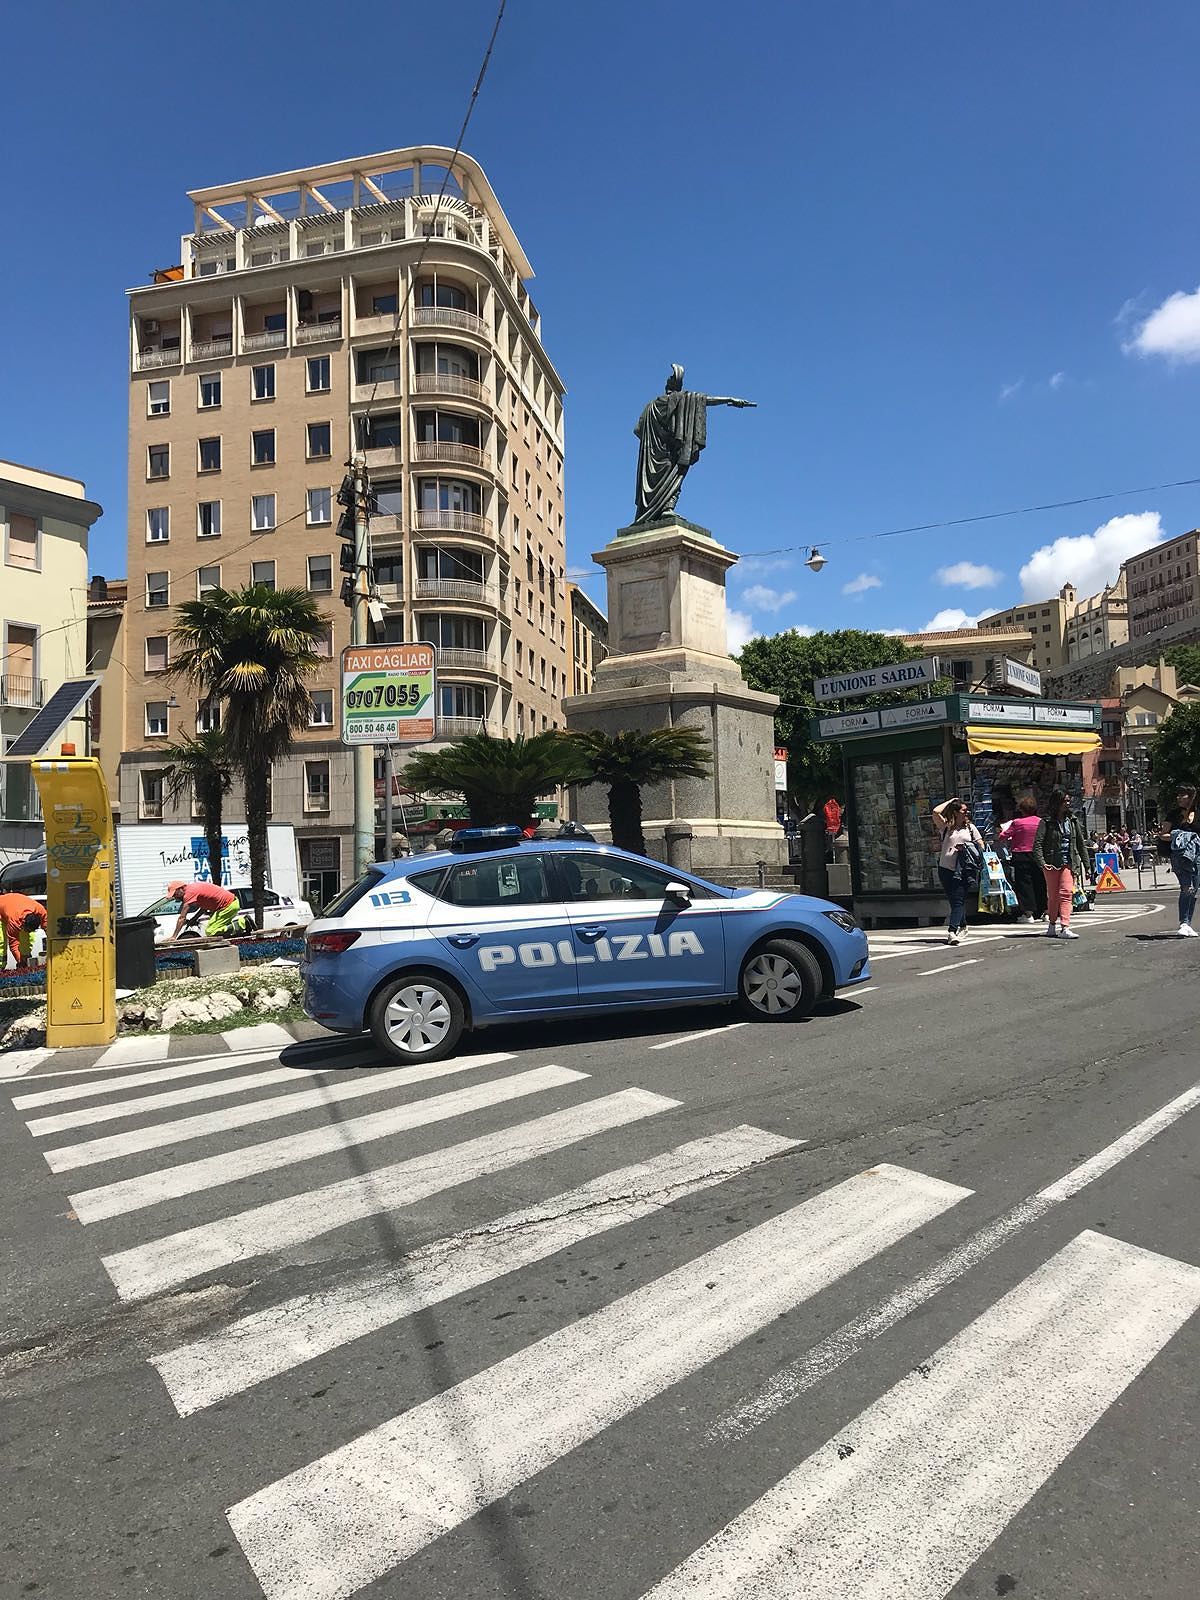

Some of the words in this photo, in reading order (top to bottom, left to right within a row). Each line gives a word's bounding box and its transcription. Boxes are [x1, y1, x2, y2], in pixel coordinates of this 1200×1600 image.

[346, 656, 371, 670] TAXI
[374, 652, 431, 669] CAGLIARI
[821, 674, 877, 696] L'UNIONE
[881, 665, 926, 685] SARDA
[349, 725, 363, 734] 800
[364, 724, 374, 733] 50
[375, 723, 385, 733] 46
[386, 723, 396, 732] 46
[368, 891, 412, 907] 113
[477, 930, 705, 972] POLIZIA
